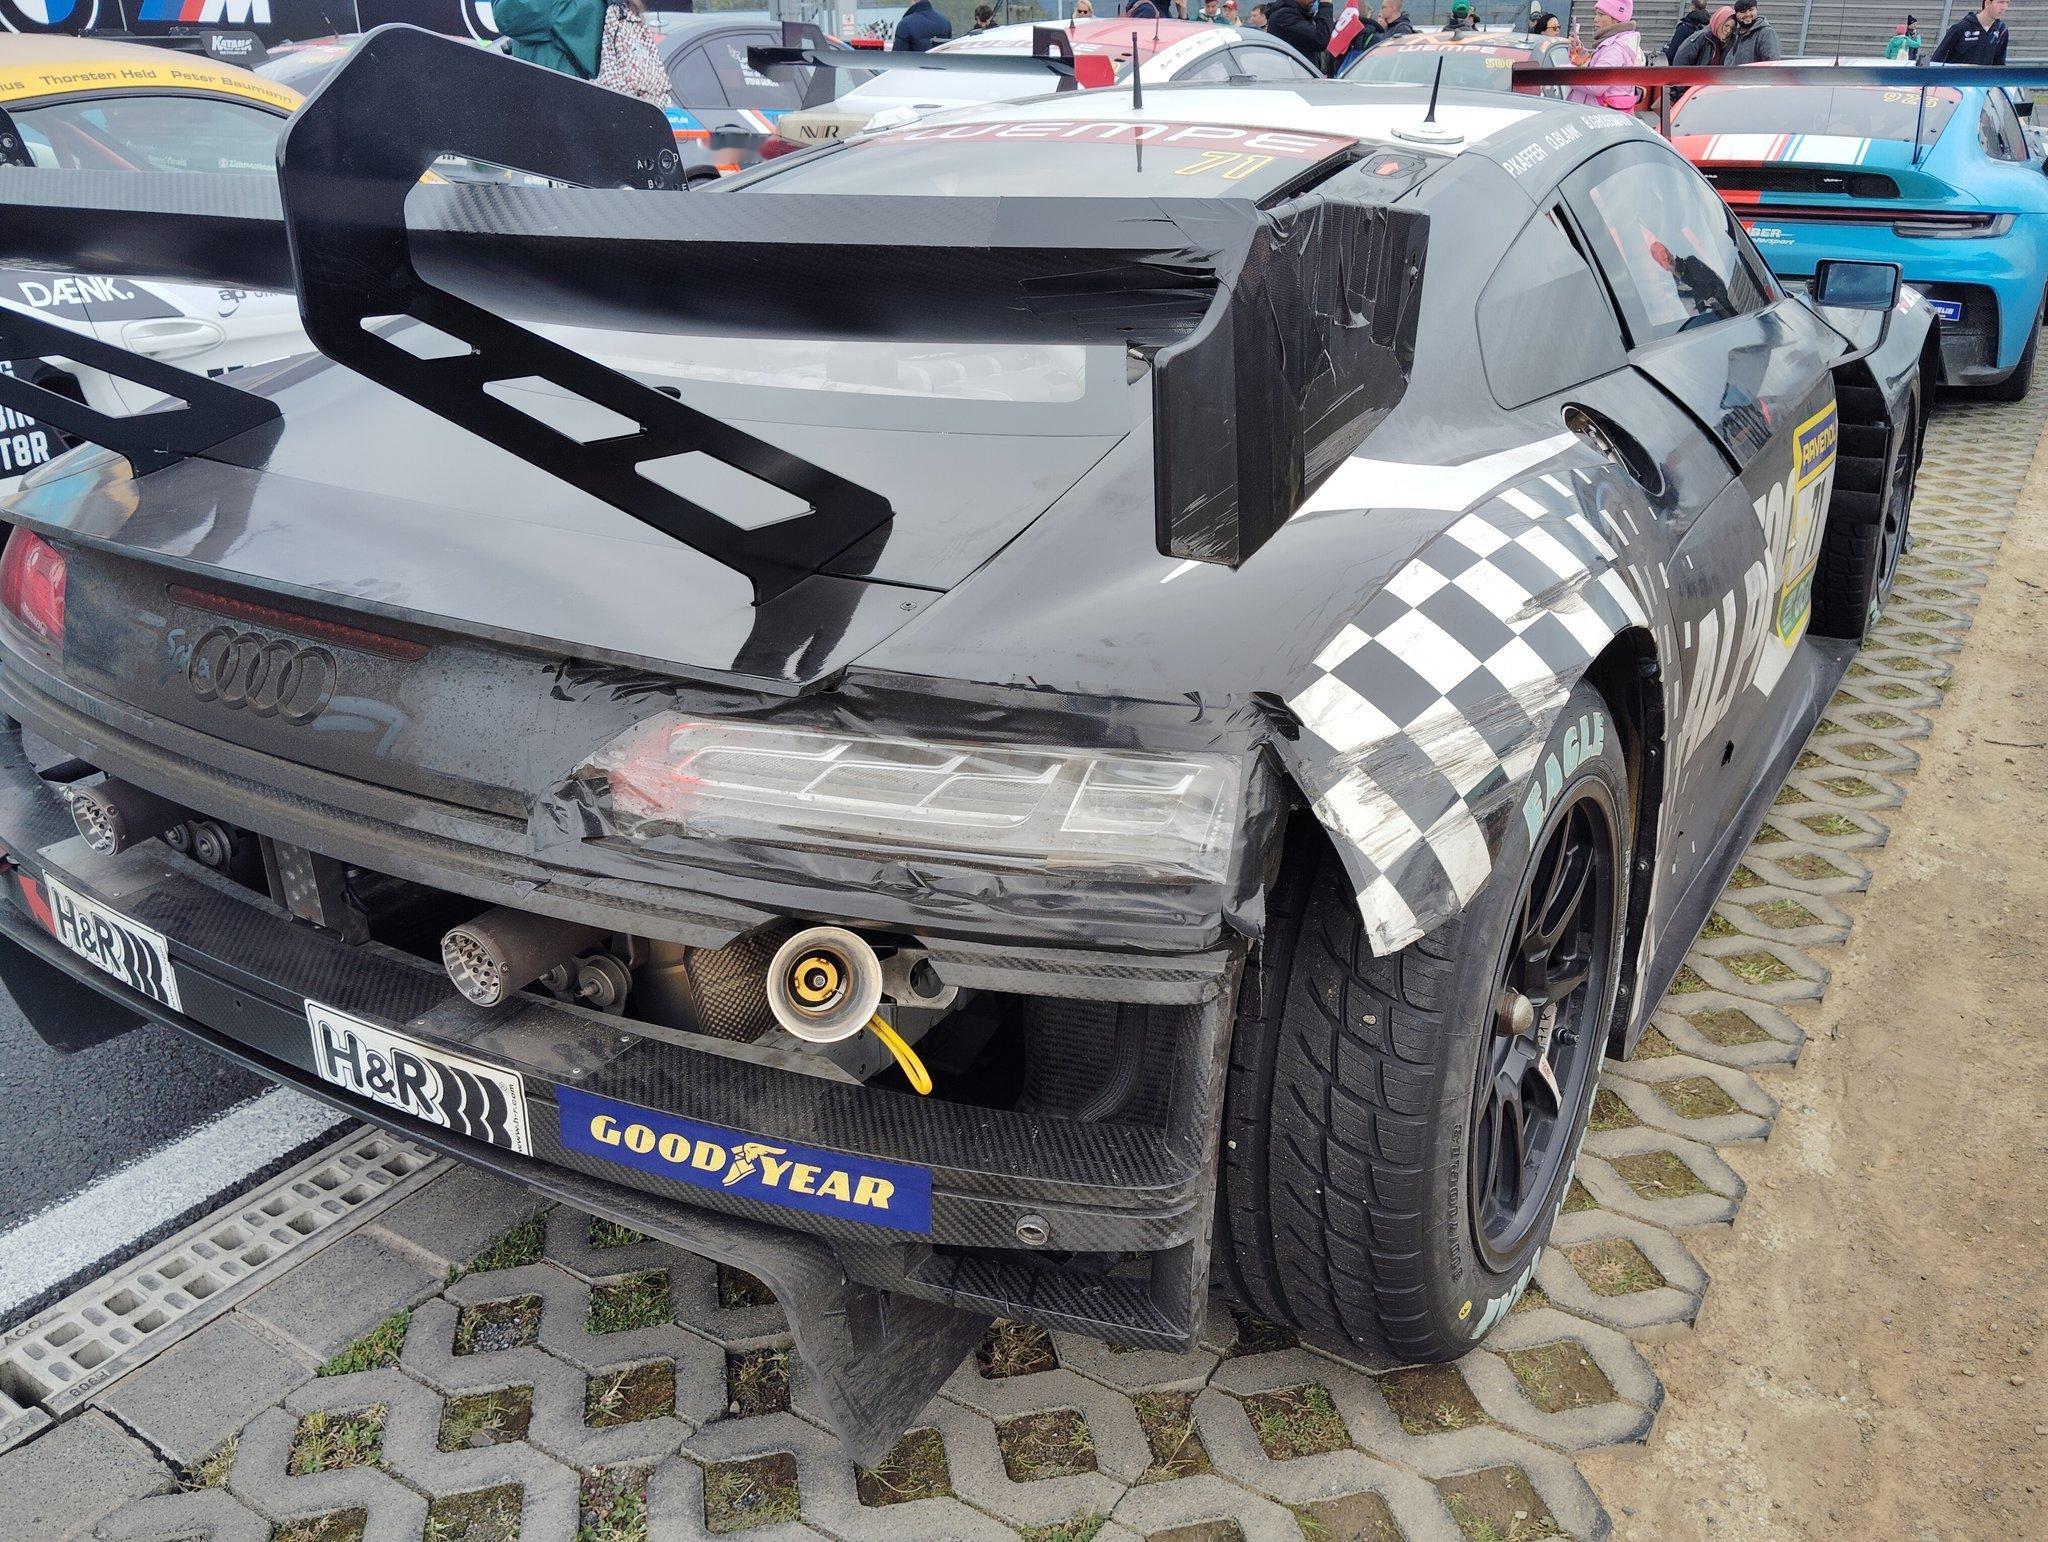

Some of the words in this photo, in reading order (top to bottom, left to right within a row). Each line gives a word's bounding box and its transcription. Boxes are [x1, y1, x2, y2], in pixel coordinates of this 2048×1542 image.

[1398, 44, 1498, 55] WEMPE
[40, 71, 117, 86] Thorsten
[120, 69, 156, 80] Held
[170, 70, 215, 82] Peter
[221, 77, 293, 104] Baumann
[903, 122, 1333, 153] WEMPE
[1174, 151, 1275, 181] 71
[53, 889, 122, 972] H&R
[323, 1025, 434, 1114] H&R
